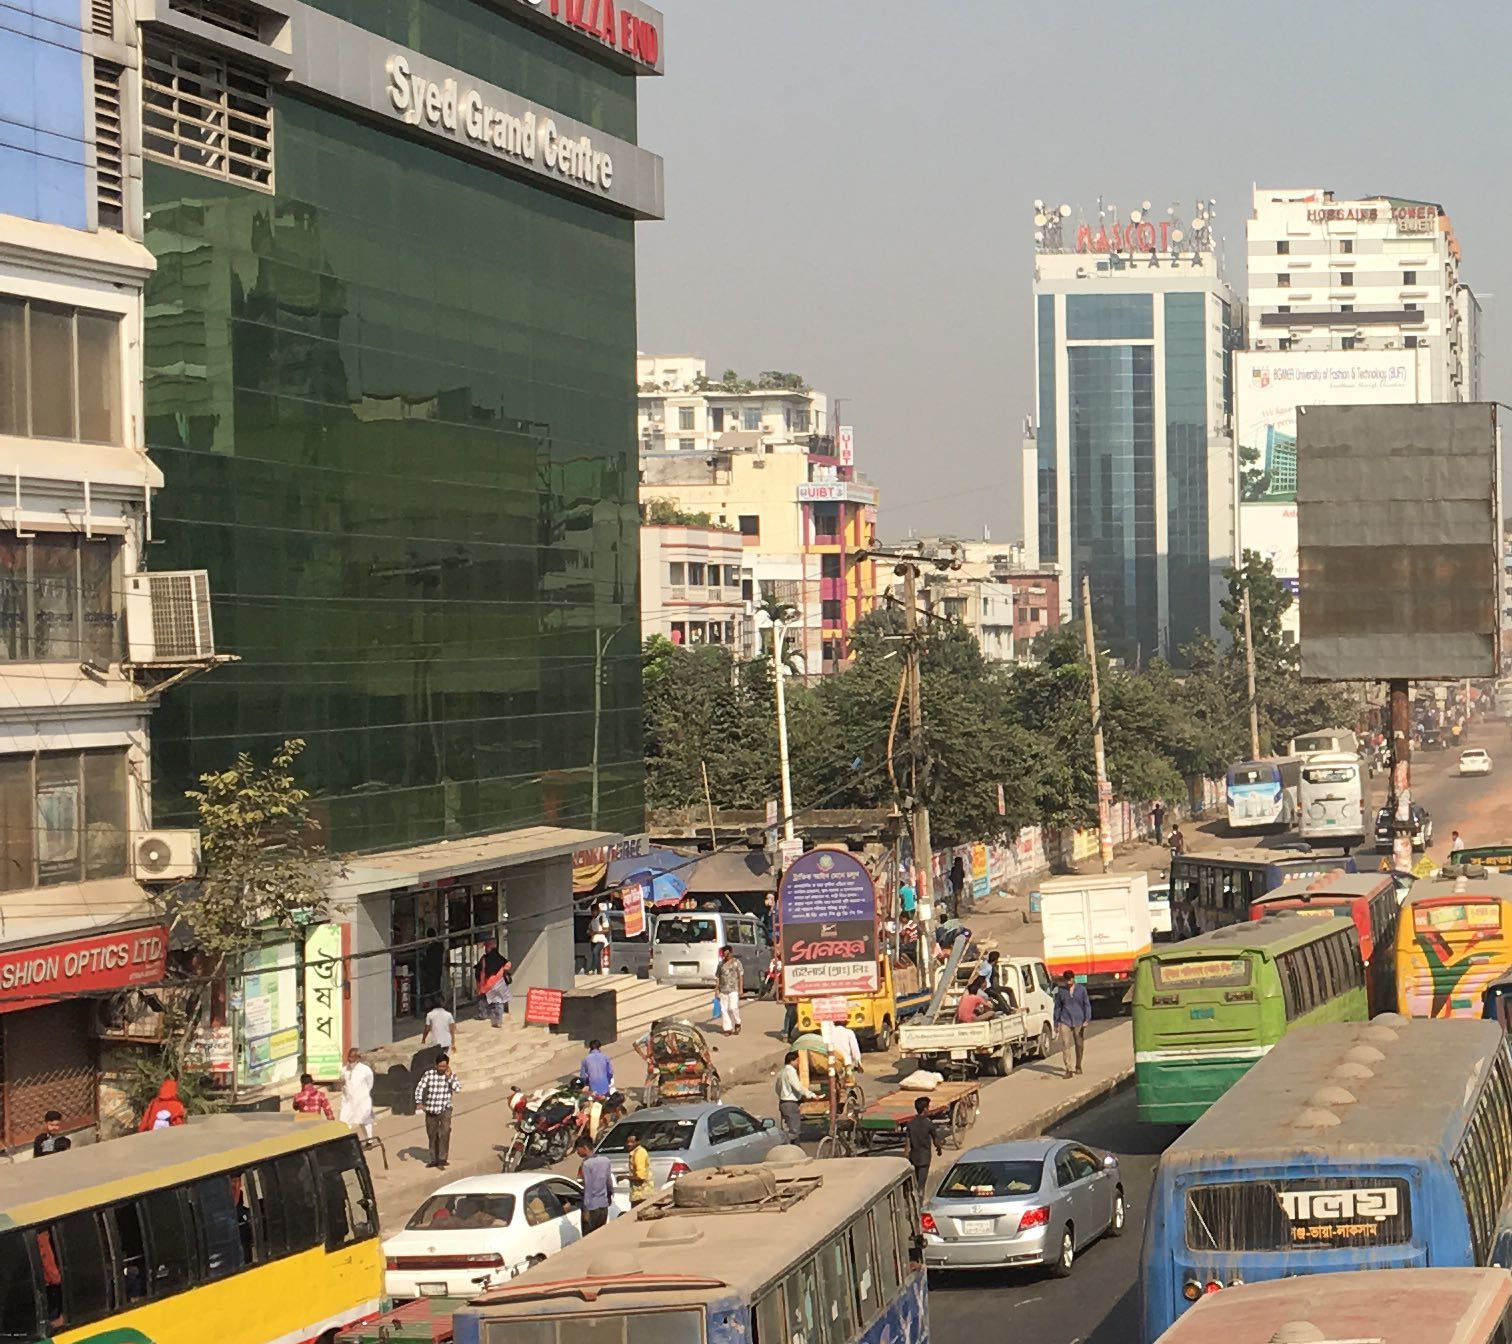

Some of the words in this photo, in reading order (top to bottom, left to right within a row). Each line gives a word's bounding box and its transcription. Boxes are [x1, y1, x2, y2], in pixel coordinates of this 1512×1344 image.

[621, 10, 658, 65] END
[386, 55, 457, 127] Syed
[459, 90, 536, 162] Grand
[539, 117, 613, 189] Centre
[1391, 207, 1436, 219] TOWER
[1077, 221, 1169, 253] MASCOT
[1109, 252, 1203, 269] PLAZA
[841, 434, 851, 465] UIBT
[808, 487, 834, 498] UIBT
[0, 958, 59, 989] SHION
[64, 943, 129, 977] OPTICS
